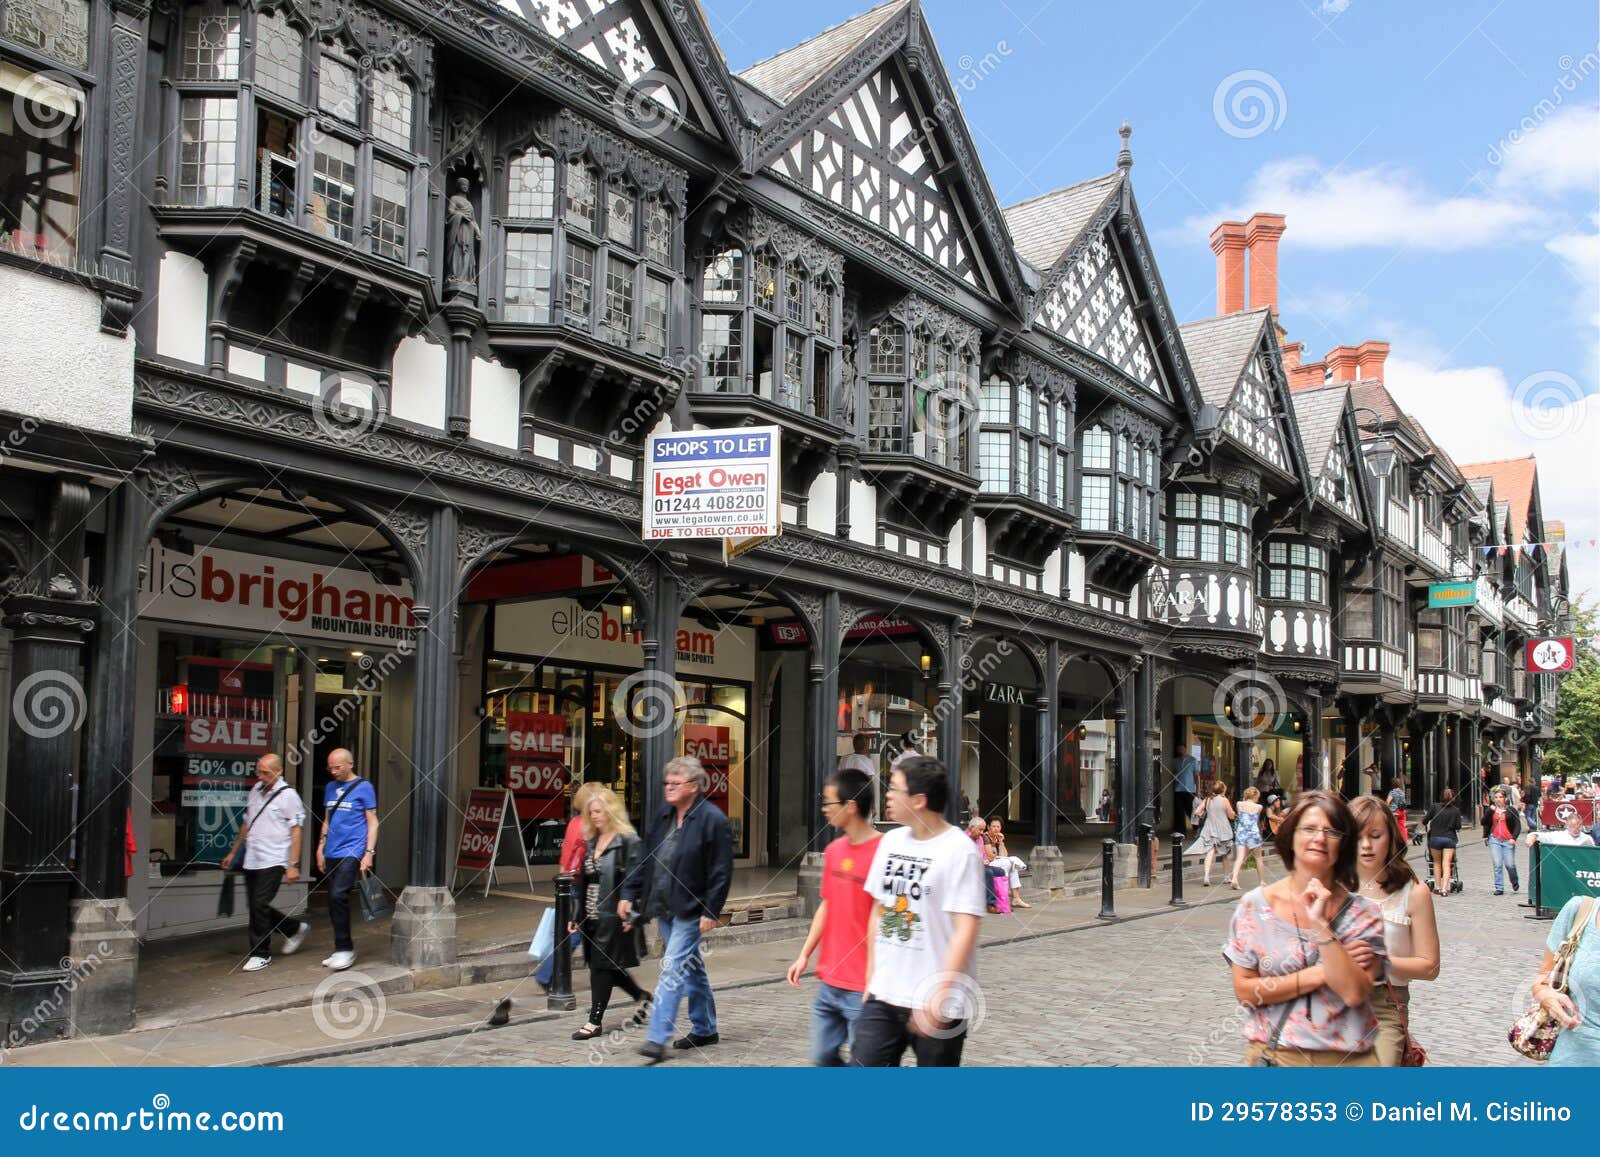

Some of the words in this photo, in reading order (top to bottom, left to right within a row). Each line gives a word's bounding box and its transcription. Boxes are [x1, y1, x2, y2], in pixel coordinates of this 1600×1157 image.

[656, 440, 708, 457] SHOPS
[713, 439, 734, 454] TO
[739, 437, 767, 453] LET
[655, 472, 702, 496] Legat
[708, 468, 766, 487] Owen
[655, 497, 700, 513] 01244
[706, 494, 765, 510] 408200
[655, 513, 764, 526] www.legatowen.co.uk
[651, 528, 673, 537] DUE
[677, 527, 692, 537] TO
[696, 525, 768, 536] RELOCATION
[149, 548, 416, 627] lisbrigham
[1153, 589, 1206, 607] ZARA
[312, 616, 371, 635] MOUNTAIN
[374, 624, 416, 641] SPORTS
[989, 682, 1025, 705] ZARA
[190, 718, 269, 746] SALE
[510, 730, 565, 753] SALE
[686, 740, 729, 760] SALE
[188, 759, 226, 775] 50%
[231, 761, 257, 776] OF
[509, 764, 563, 790] 50%
[702, 772, 728, 793] 0%
[468, 805, 502, 823] SALE
[460, 832, 494, 853] 50%
